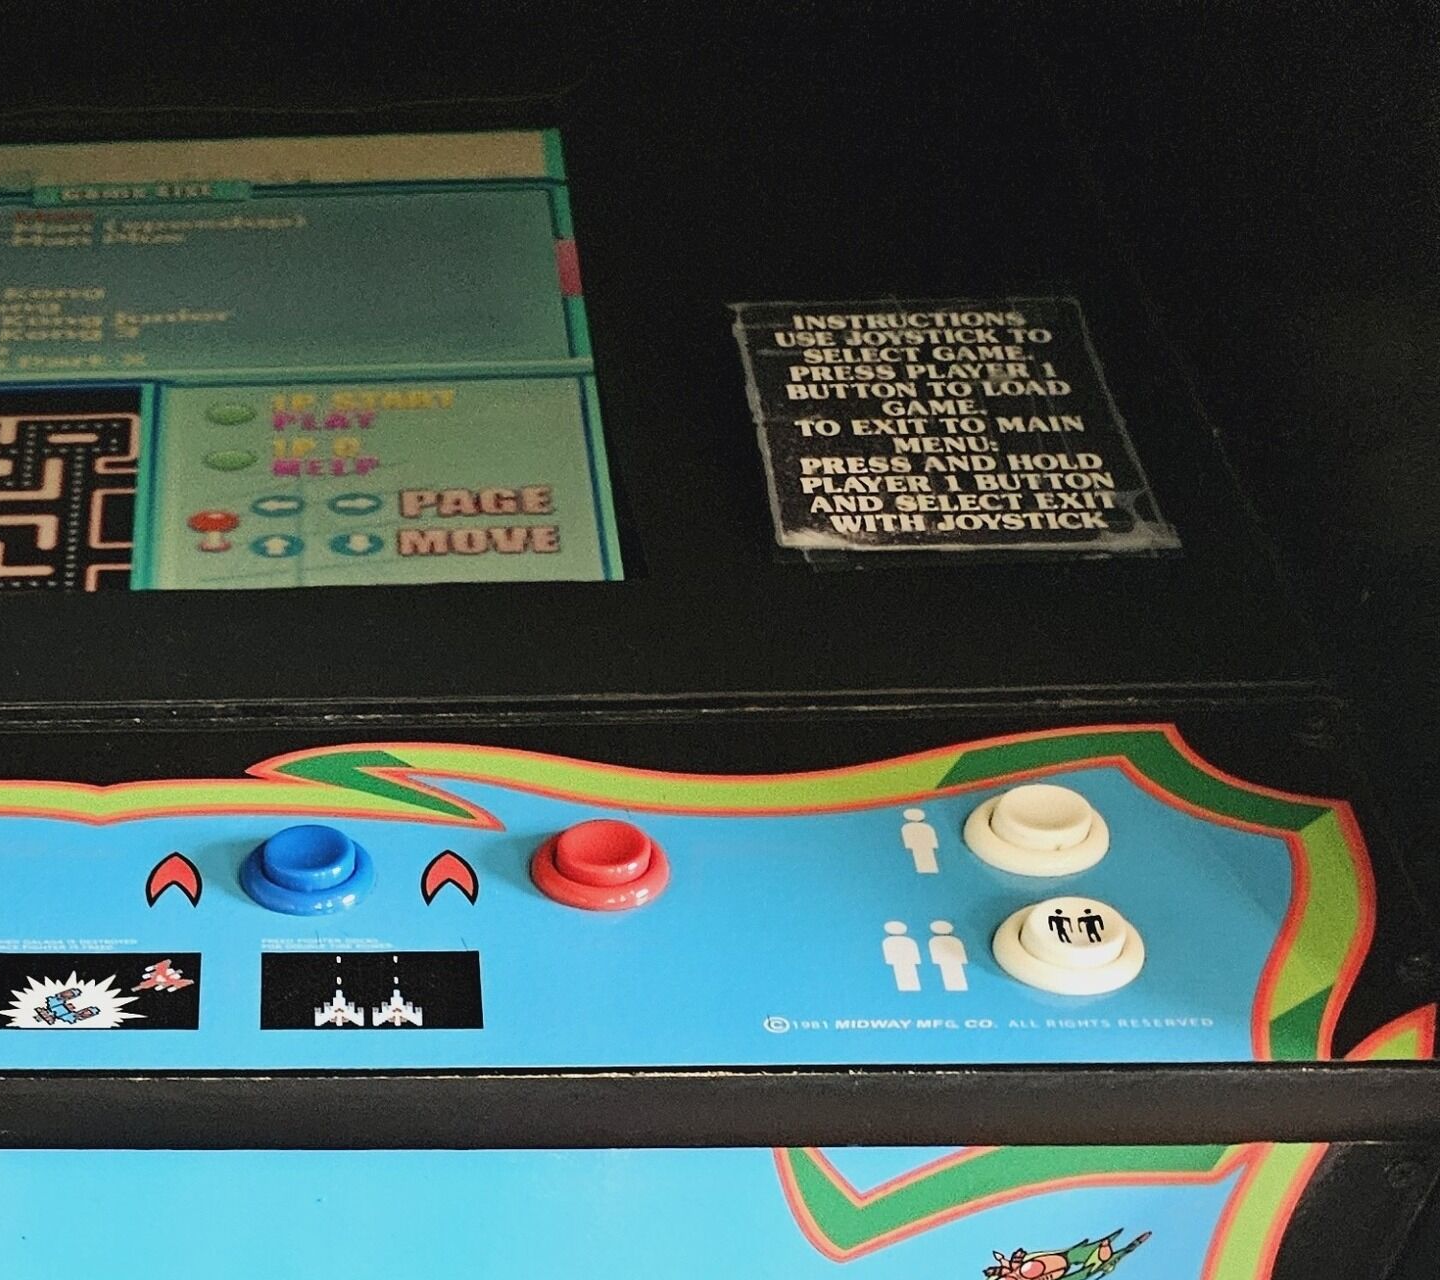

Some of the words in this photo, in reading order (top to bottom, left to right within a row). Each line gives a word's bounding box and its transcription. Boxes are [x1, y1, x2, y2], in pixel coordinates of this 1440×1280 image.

[792, 312, 1026, 330] INSTRUCTIONS
[774, 331, 836, 348] USE
[846, 328, 1000, 346] JOYSTICK
[1007, 328, 1052, 344] TO
[802, 347, 920, 364] SELECT
[931, 346, 1034, 362] GAME.
[788, 365, 896, 382] PRESS
[906, 363, 1030, 381] PLAYER
[1043, 362, 1057, 378] 1
[785, 382, 918, 400] BUTTON
[926, 381, 972, 397] TO
[981, 380, 1071, 397] LOAD
[882, 400, 988, 416] GAME.
[272, 411, 376, 430] PLAY
[794, 419, 841, 437] TO
[852, 418, 928, 436] EXIT
[939, 418, 986, 434] TO
[997, 416, 1084, 433] MAIN
[893, 437, 999, 454] MENU:
[272, 456, 380, 477] HELP
[800, 456, 912, 475] PRESS
[924, 455, 997, 473] AND
[1006, 453, 1103, 471] HOLD
[800, 476, 931, 494] PLAYER
[946, 475, 960, 493] 1
[974, 472, 1115, 491] BUTTON
[399, 486, 554, 517] PAGE
[810, 495, 883, 513] AND
[895, 494, 1023, 512] SELECT
[1033, 492, 1115, 510] EXIT
[830, 514, 925, 533] WITH
[936, 512, 1109, 531] JOYSTICK
[396, 525, 561, 556] MOVE
[835, 1020, 911, 1029] MIDWAY
[964, 1019, 998, 1029] CO.
[1008, 1019, 1039, 1029] ALL
[1046, 1018, 1111, 1029] RIGHTS
[1118, 1017, 1214, 1028] RESERVED
